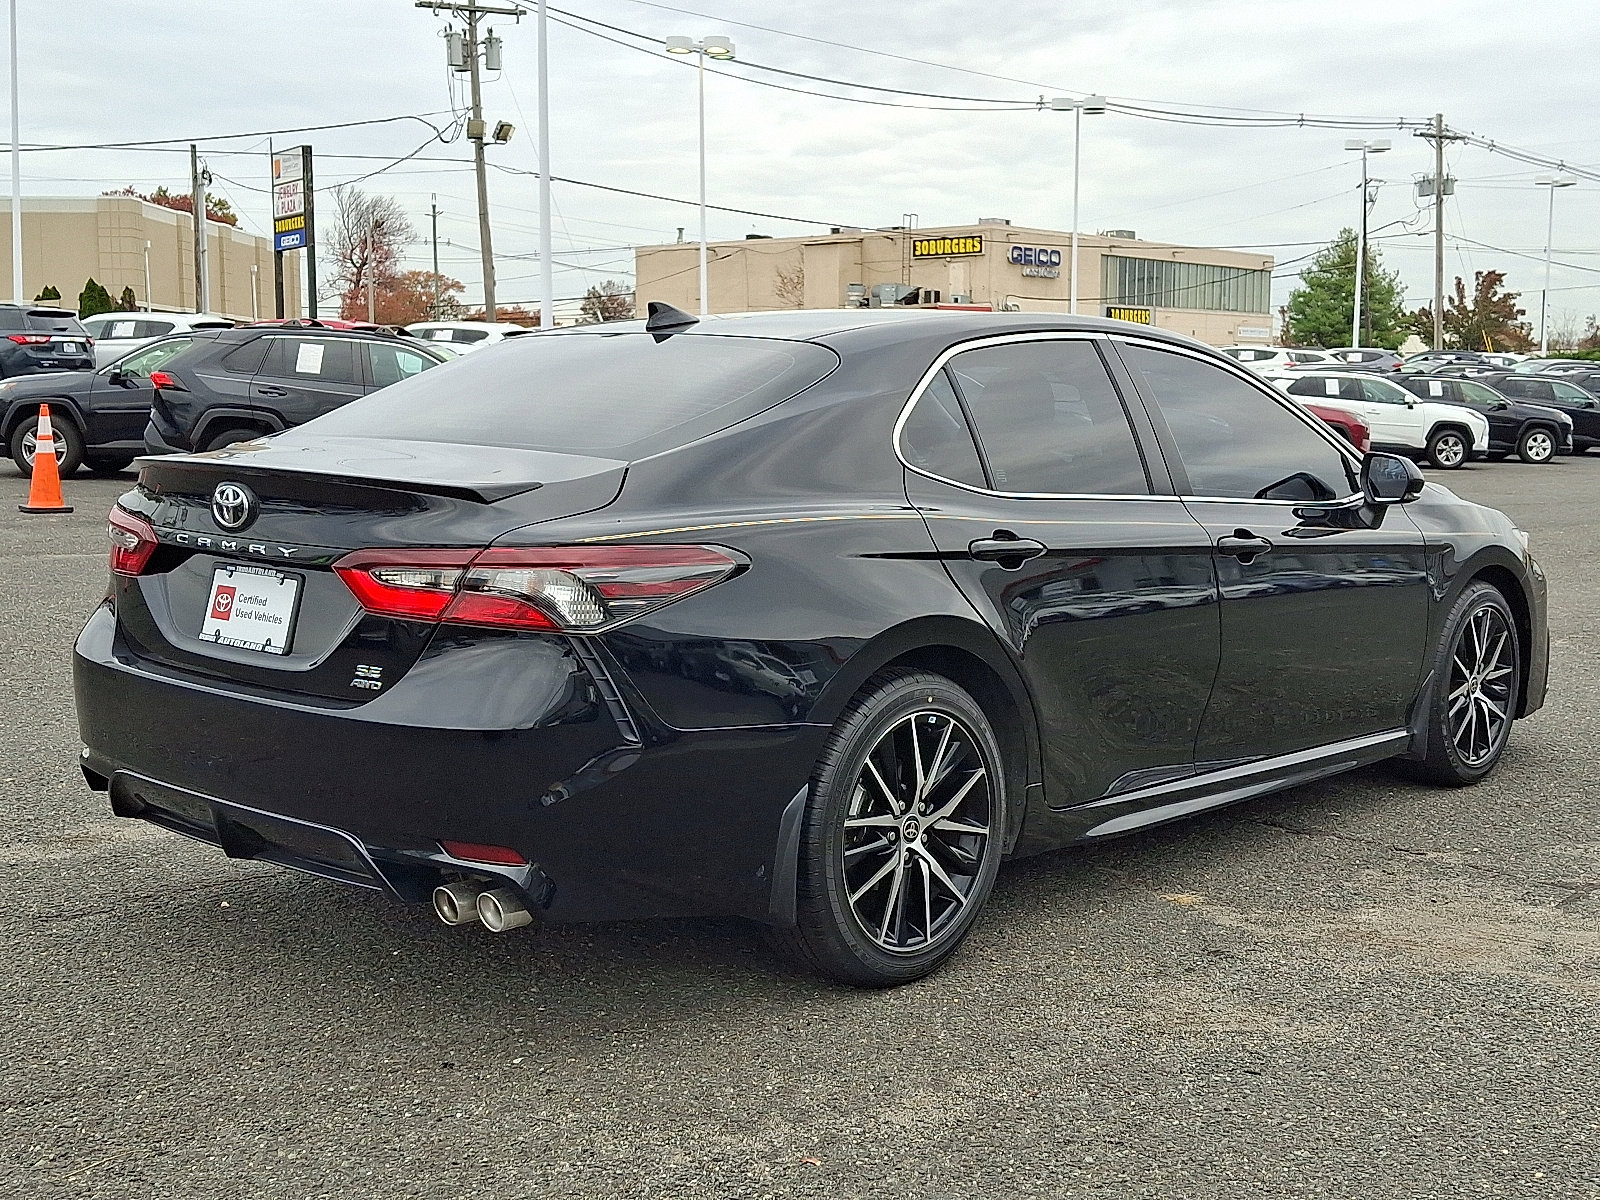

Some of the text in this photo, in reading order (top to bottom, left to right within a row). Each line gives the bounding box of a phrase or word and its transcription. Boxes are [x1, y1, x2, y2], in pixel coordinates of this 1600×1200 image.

[281, 198, 297, 214] PLAZA
[281, 234, 300, 246] GEICO
[1011, 245, 1061, 267] GEICO
[176, 533, 298, 557] CAMRY
[238, 593, 268, 607] Certified
[235, 608, 283, 625] Used Vehicles
[217, 635, 263, 651] AUTOLAND
[355, 664, 383, 678] SE
